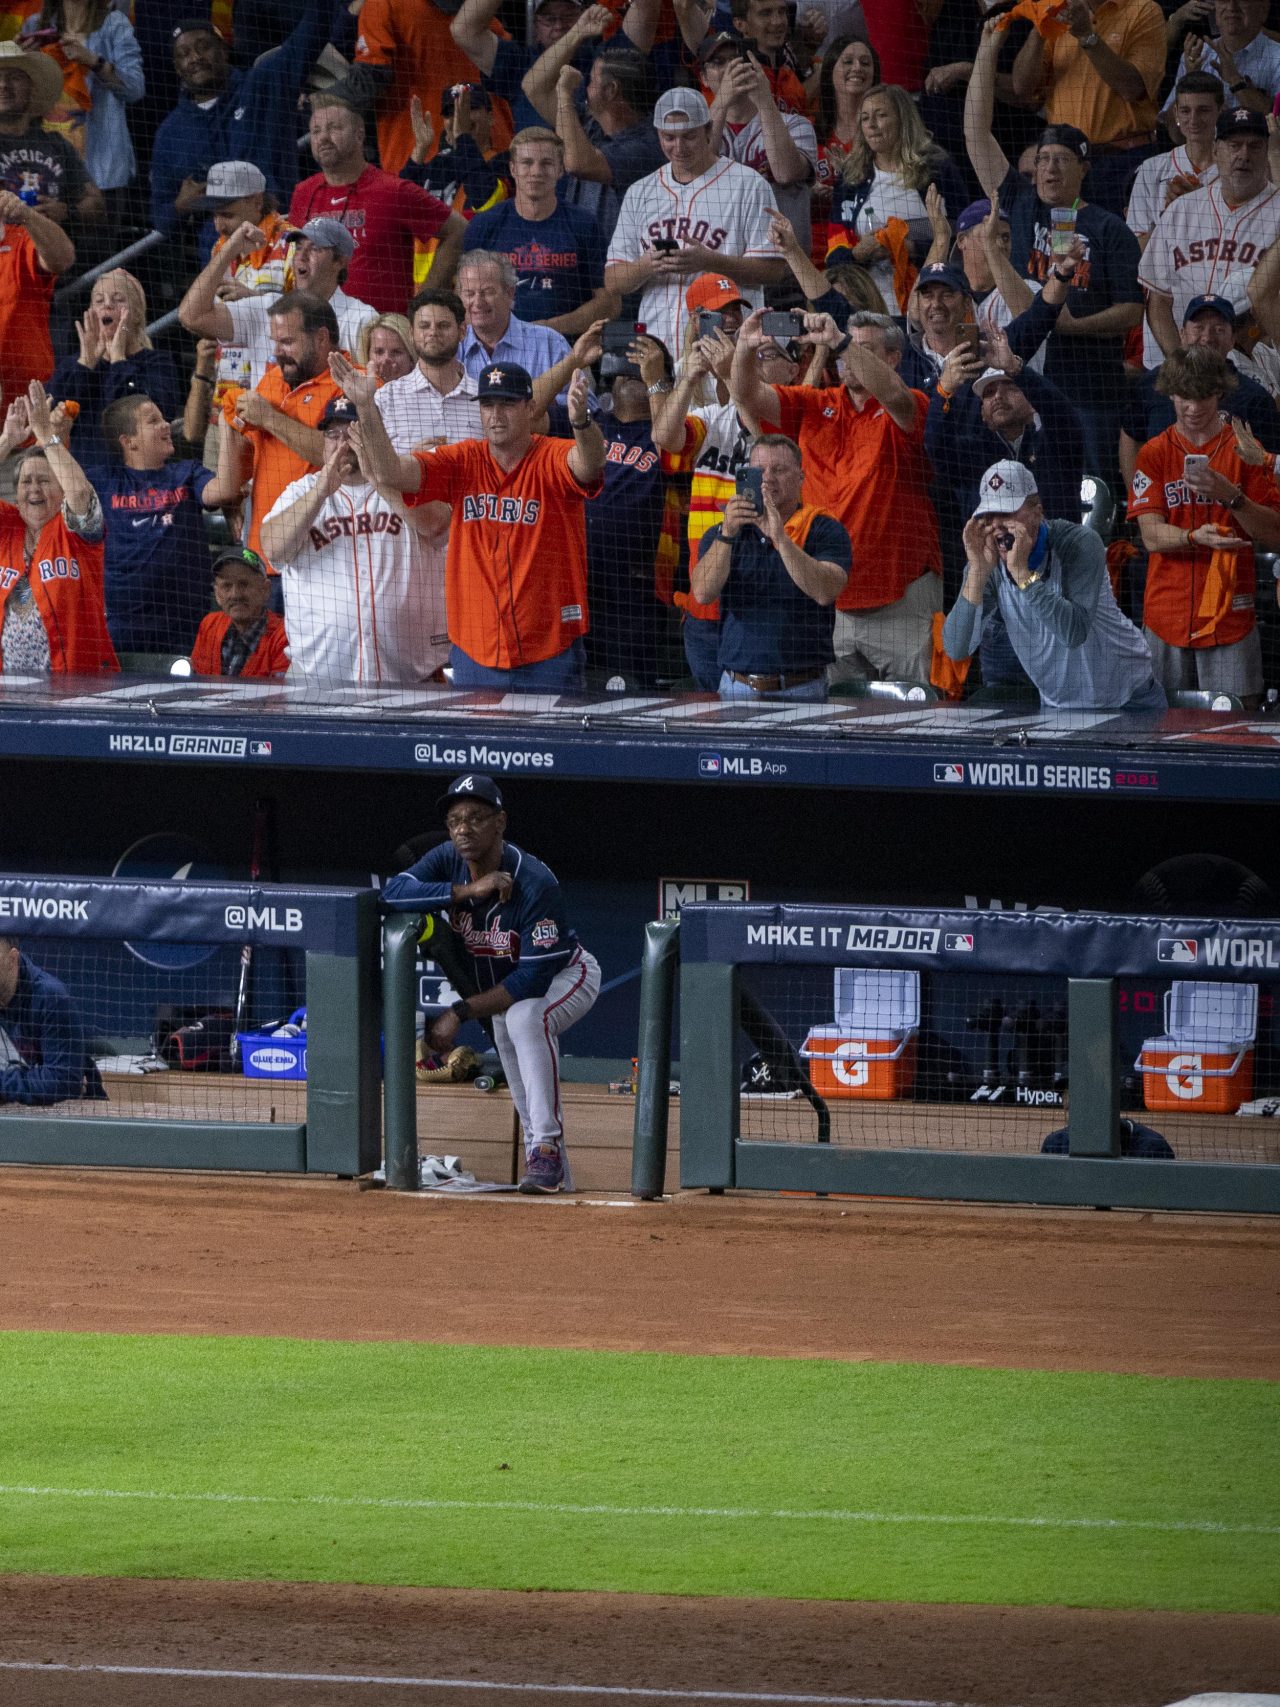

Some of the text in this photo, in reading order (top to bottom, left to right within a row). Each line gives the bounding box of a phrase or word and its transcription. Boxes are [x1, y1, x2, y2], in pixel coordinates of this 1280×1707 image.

[0, 148, 64, 178] AMERICAN
[462, 493, 540, 526] ASTROS
[309, 511, 404, 552] ASTROS
[109, 735, 246, 755] HAZLO GRANDE
[414, 743, 554, 770] @Las Mayores
[722, 757, 788, 776] MLB App
[967, 762, 1159, 790] WORLD SERIES 2021
[225, 905, 303, 932] @MLB
[536, 925, 556, 938] 150
[746, 924, 939, 951] MAKE IT MAJOR
[252, 1055, 294, 1065] BLUE-EMU
[831, 1041, 869, 1087] G
[1166, 1054, 1203, 1100] G
